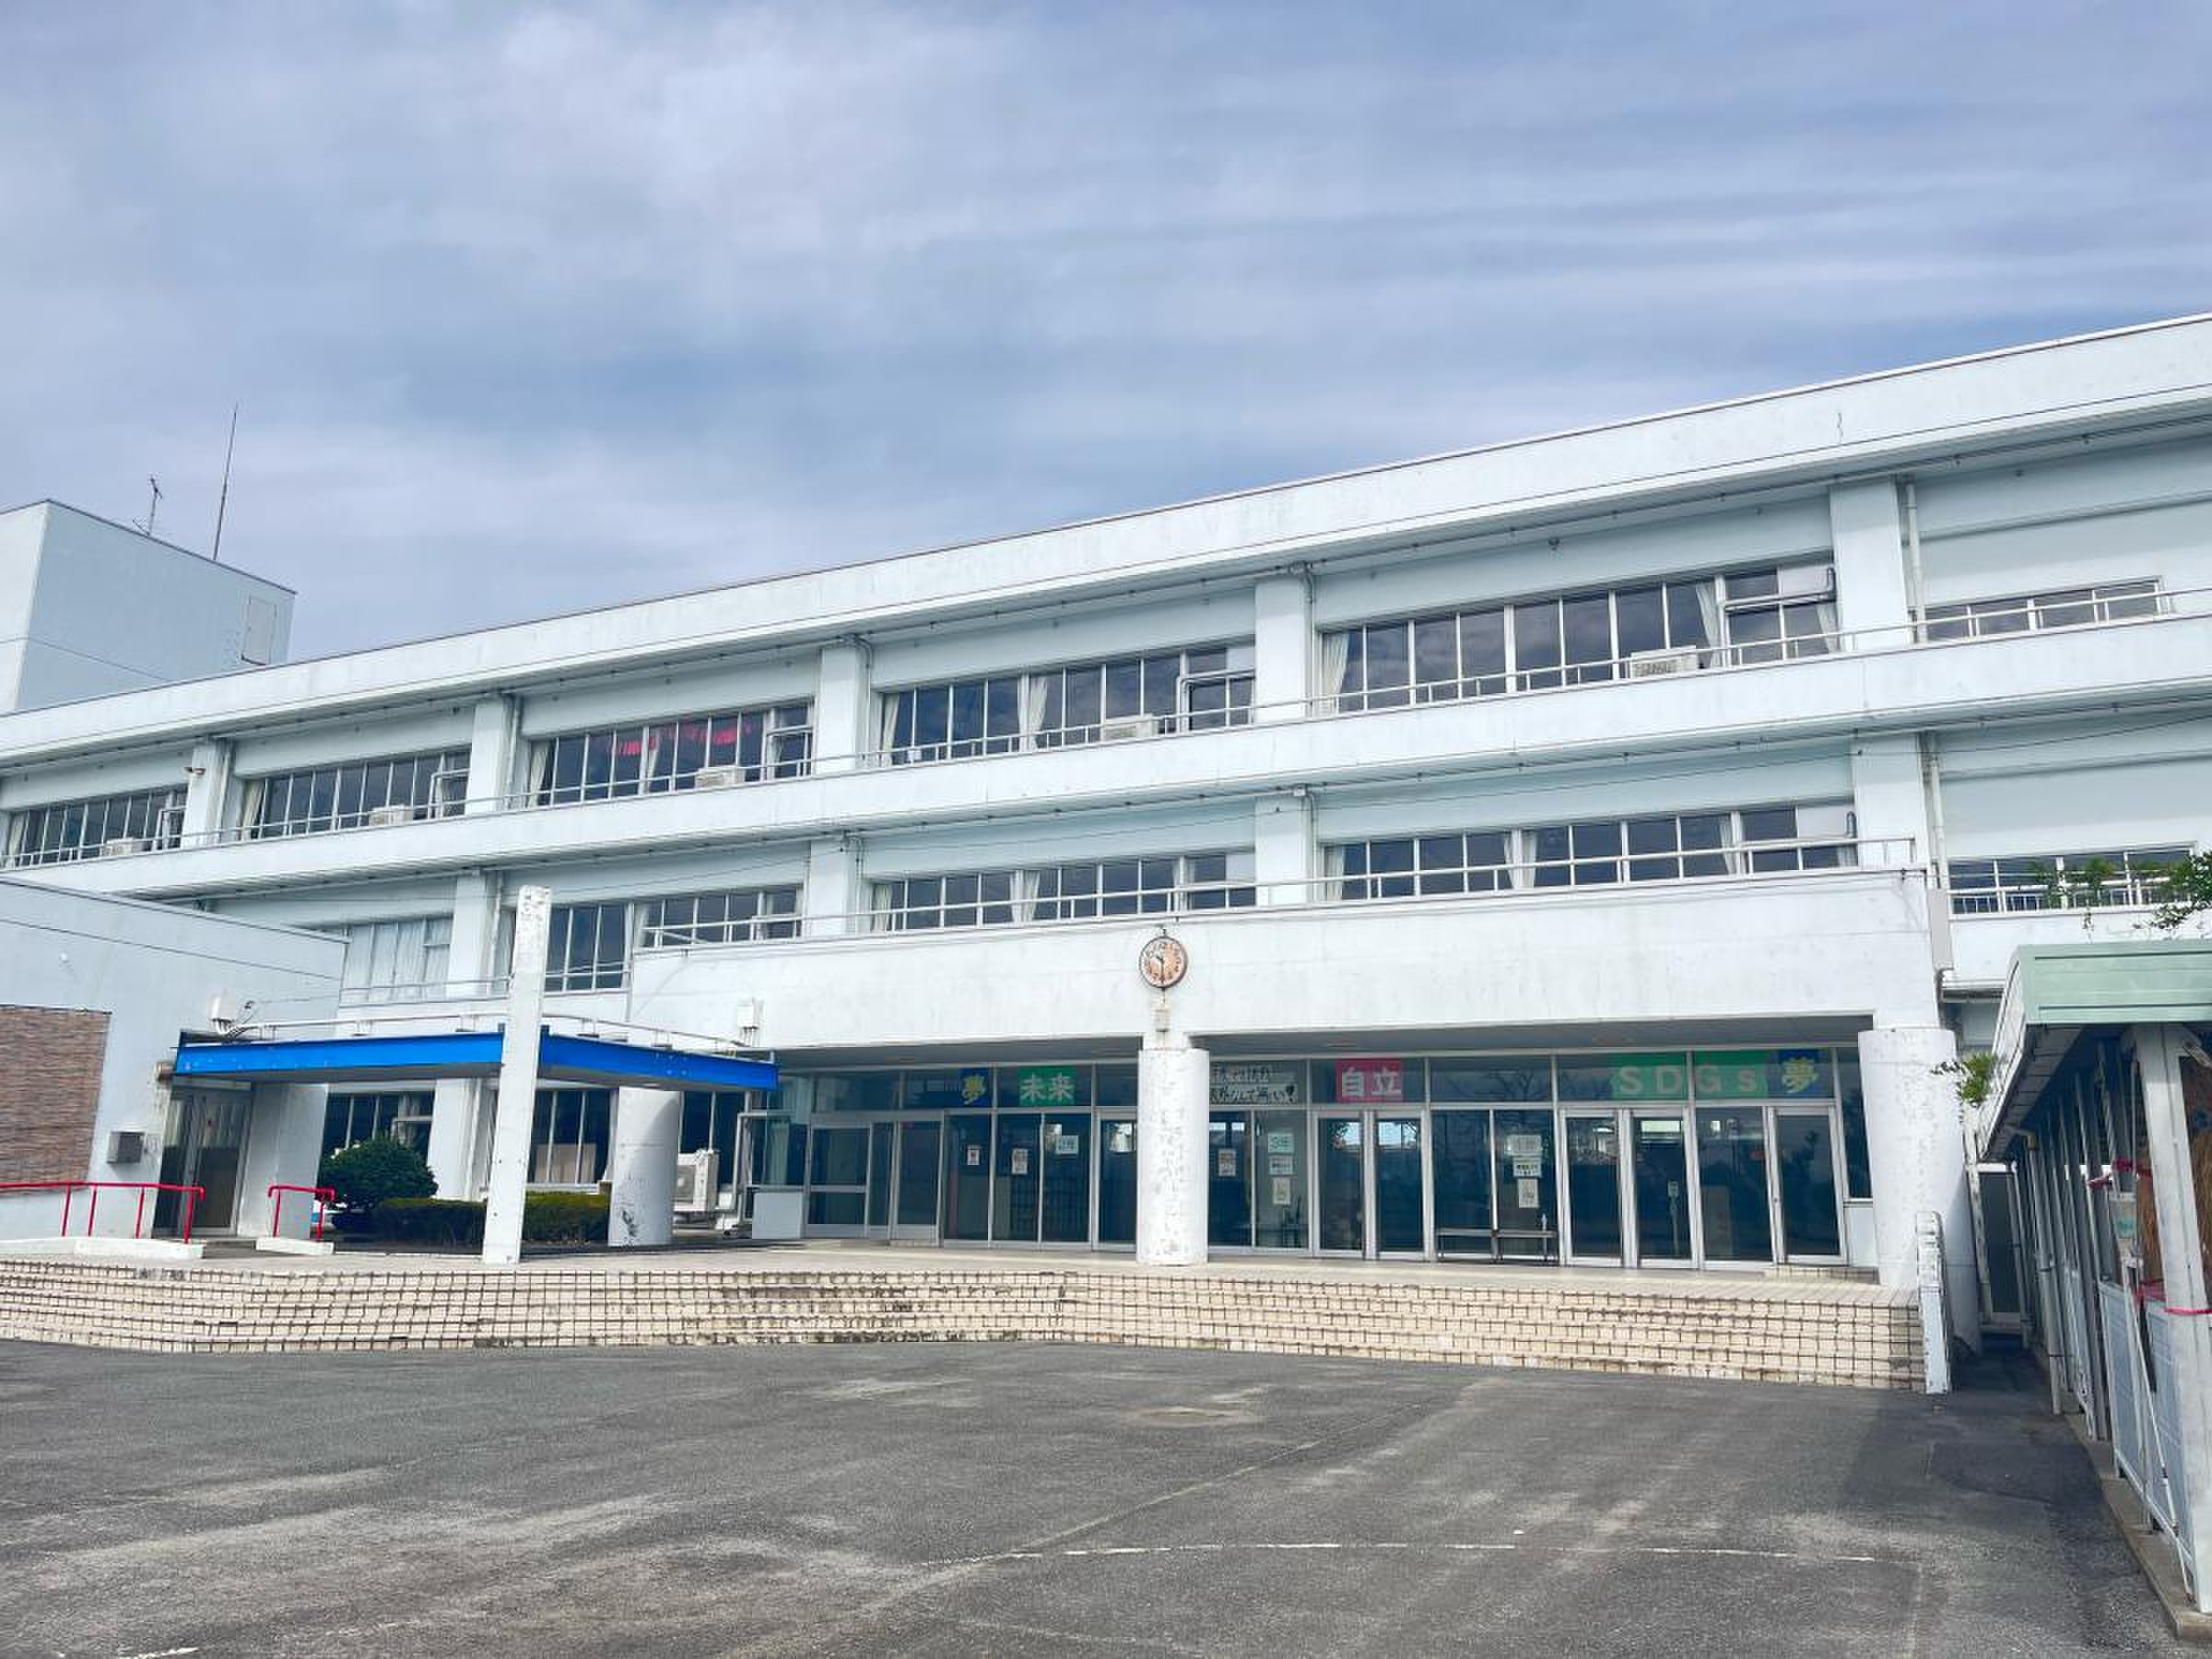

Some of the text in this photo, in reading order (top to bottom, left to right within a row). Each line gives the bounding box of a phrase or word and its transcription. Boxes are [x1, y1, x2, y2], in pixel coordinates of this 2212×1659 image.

[962, 1074, 985, 1104] 夢
[1019, 1072, 1075, 1102] 未来
[1342, 1066, 1402, 1098] 自立
[1620, 1064, 1758, 1093] SDGs
[1782, 1057, 1818, 1093] 夢
